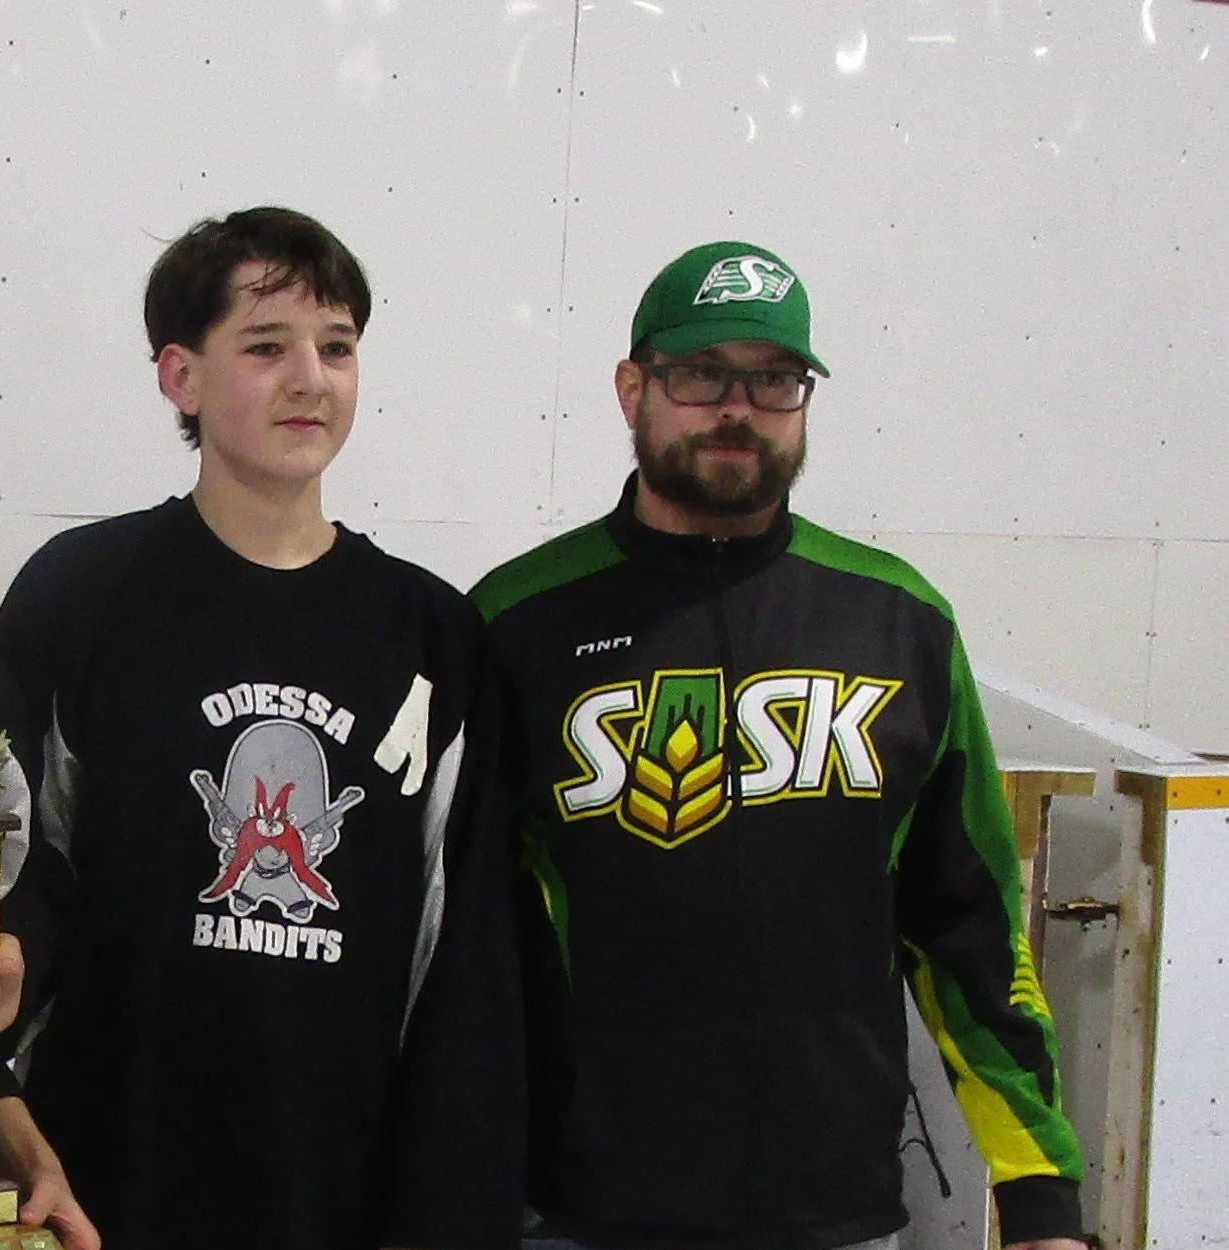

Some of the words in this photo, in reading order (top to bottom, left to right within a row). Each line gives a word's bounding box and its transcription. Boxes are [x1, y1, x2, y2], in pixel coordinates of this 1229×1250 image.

[575, 635, 633, 657] MNM
[201, 683, 356, 745] ODESSA
[554, 667, 904, 849] SASK
[192, 914, 343, 963] BANDITS
